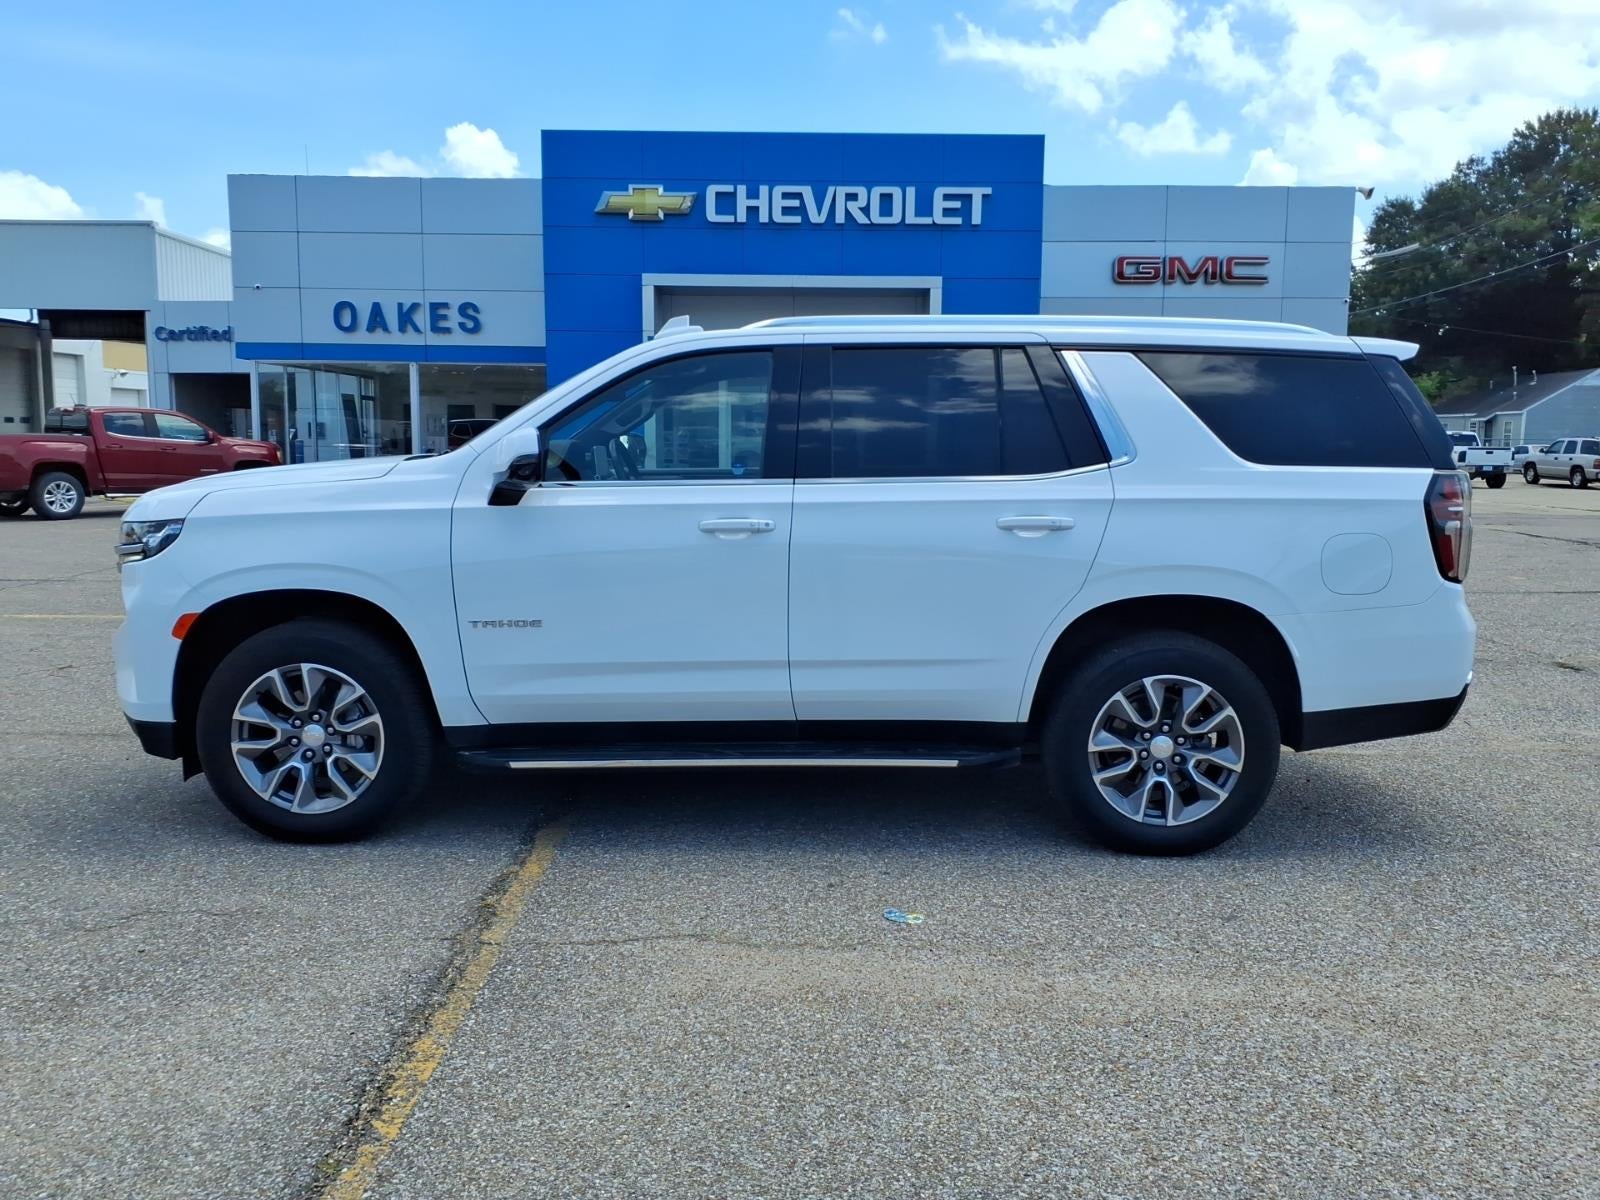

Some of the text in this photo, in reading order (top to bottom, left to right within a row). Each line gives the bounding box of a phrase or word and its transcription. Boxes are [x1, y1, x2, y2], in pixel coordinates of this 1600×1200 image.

[705, 184, 993, 225] CHEVROLET
[1114, 255, 1269, 284] GMC
[333, 301, 482, 334] OAKES
[155, 325, 232, 342] Certified
[468, 619, 543, 629] TAHOE
